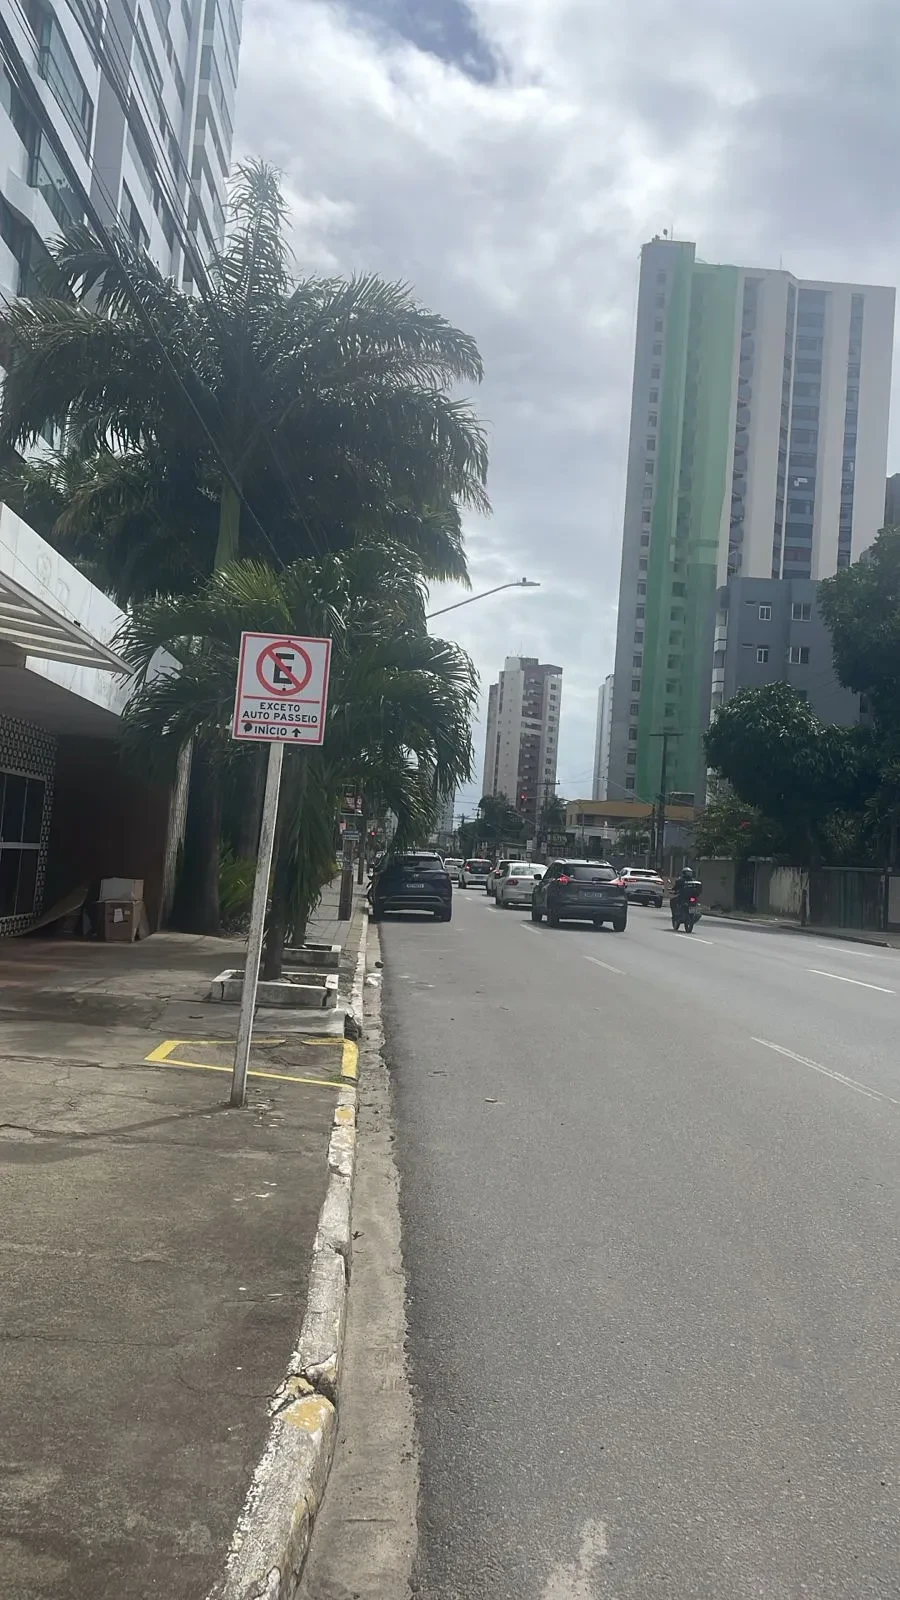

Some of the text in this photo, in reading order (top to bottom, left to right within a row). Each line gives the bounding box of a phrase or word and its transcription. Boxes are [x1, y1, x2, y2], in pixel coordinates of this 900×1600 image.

[273, 653, 295, 684] E
[260, 702, 301, 712] EXCETO
[242, 711, 318, 724] AUTO PASSEIO
[254, 723, 287, 736] INÍCIO
